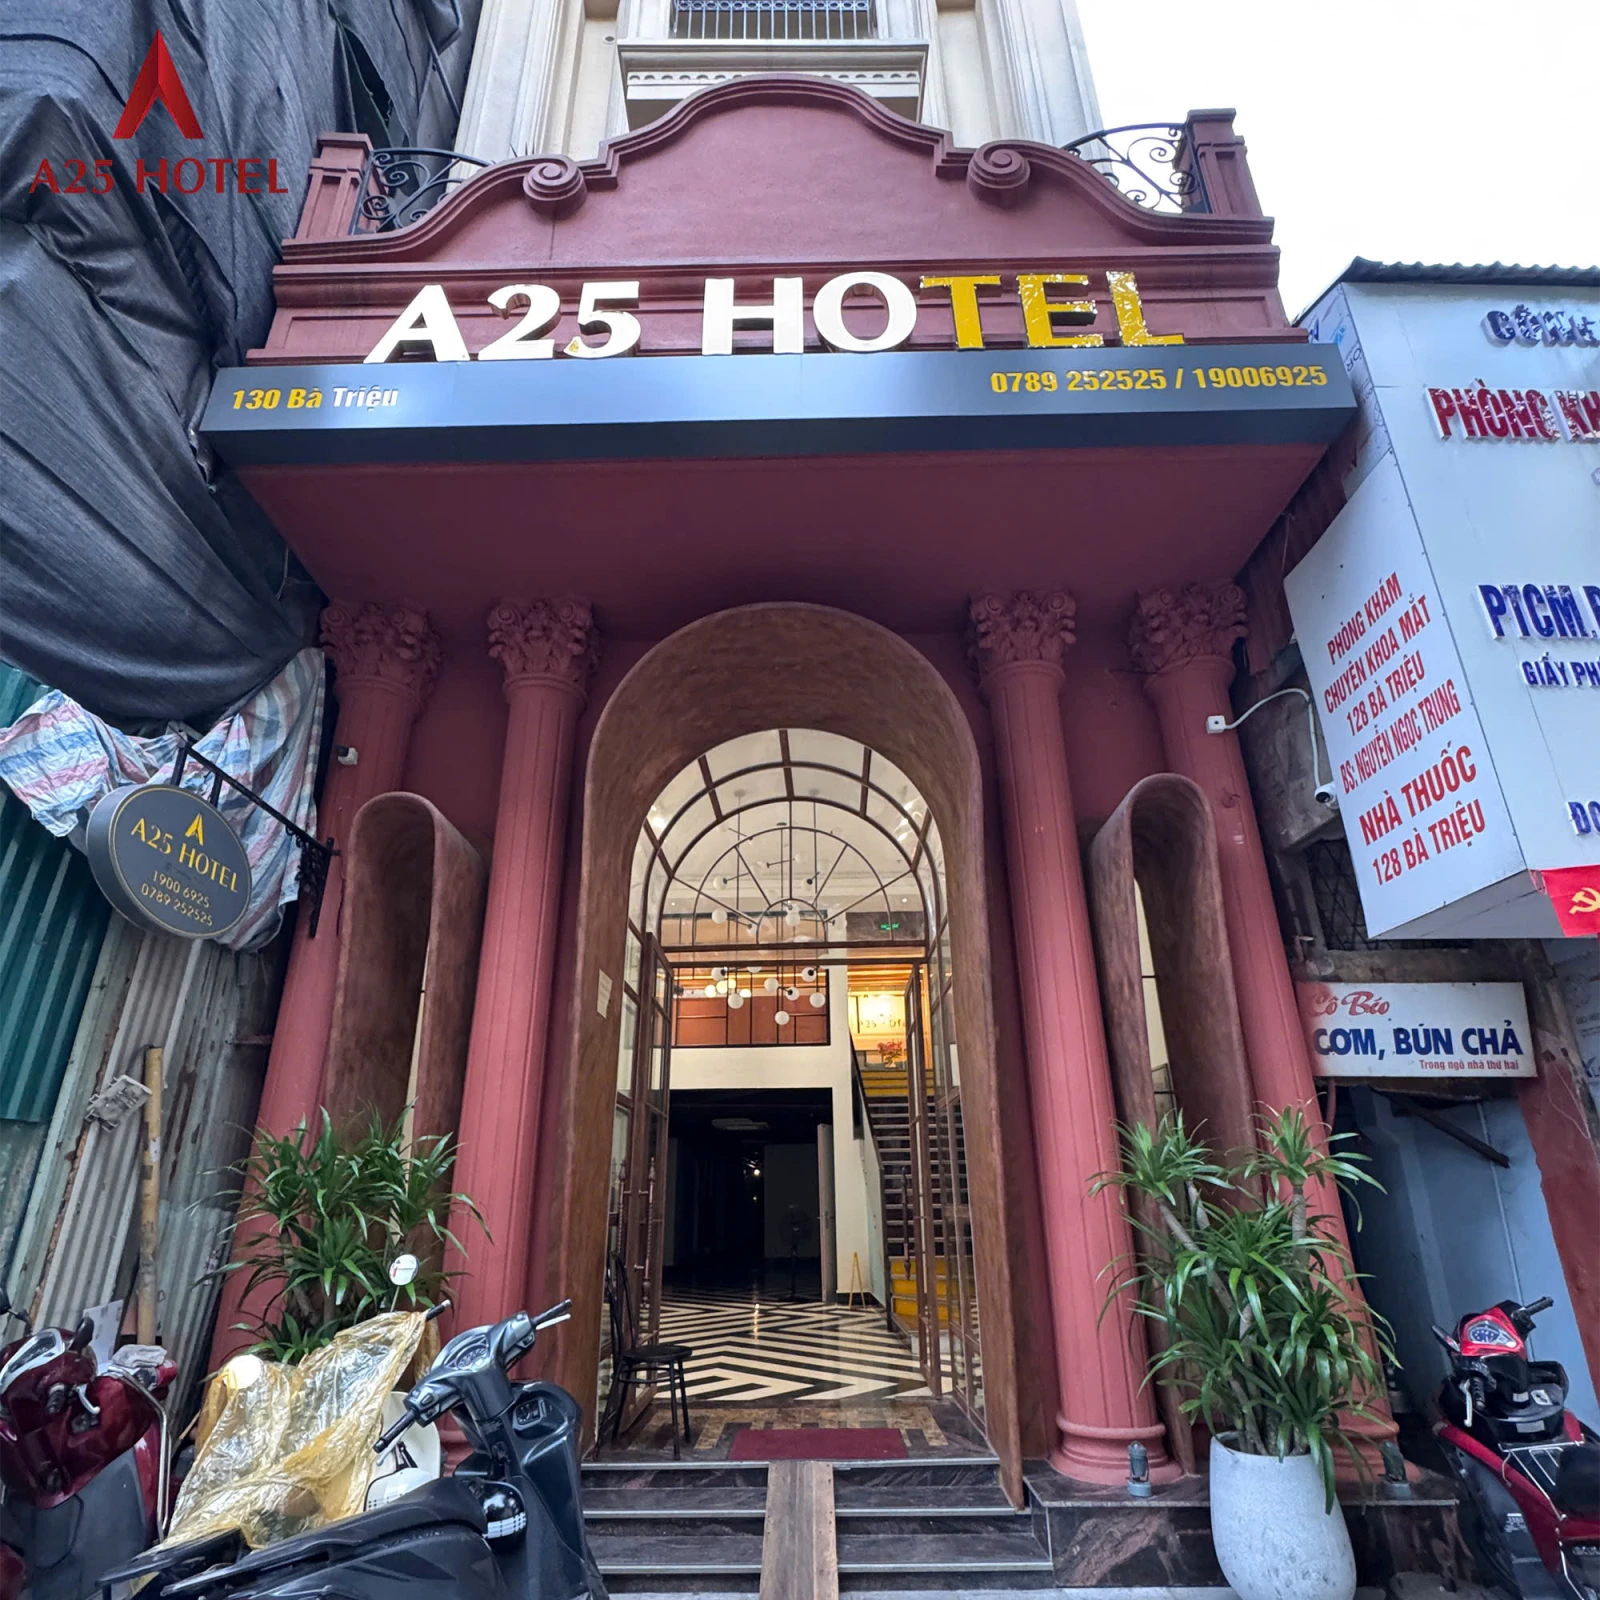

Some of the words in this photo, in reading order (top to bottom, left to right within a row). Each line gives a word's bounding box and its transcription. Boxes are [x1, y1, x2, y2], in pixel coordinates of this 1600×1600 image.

[363, 281, 642, 364] A25
[701, 271, 1187, 356] HOTEL
[232, 389, 282, 410] 130
[287, 386, 323, 409] Bà
[333, 385, 399, 412] Triệu
[990, 371, 1058, 393] 0789
[1066, 368, 1167, 391] 252525
[1175, 367, 1184, 389] /
[1192, 365, 1328, 389] 19006925
[1427, 378, 1560, 440] PHÒNG
[1327, 621, 1366, 665] PHÒNG
[1363, 571, 1403, 627] KHÁM
[1323, 656, 1368, 714] CHUYÊN
[1365, 627, 1400, 676] KHOA
[1398, 592, 1431, 644] MẮT
[1521, 652, 1570, 686] GIẤY
[1346, 701, 1369, 736] 128
[1368, 680, 1388, 719] BÀ
[1385, 650, 1425, 702] TRIỆU
[1390, 708, 1422, 752] NGỌC
[1418, 679, 1461, 734] TRUNG
[1359, 790, 1403, 846] NHÀ
[1401, 740, 1477, 818] THUỐC
[130, 817, 174, 855] A25
[178, 843, 237, 893] HOTEL
[1372, 848, 1402, 885] 128
[1402, 827, 1429, 870] BÀ
[1428, 799, 1485, 854] TRIỆU
[141, 883, 170, 905] 0789
[173, 899, 213, 927] 252525
[153, 870, 180, 893] 1900
[183, 887, 210, 908] 6925
[1313, 1028, 1385, 1060] CƠM,
[1393, 1023, 1454, 1055] BÚN
[1461, 1020, 1523, 1055] CHẢ
[1419, 1059, 1446, 1071] Trong
[1503, 1059, 1519, 1070] hai
